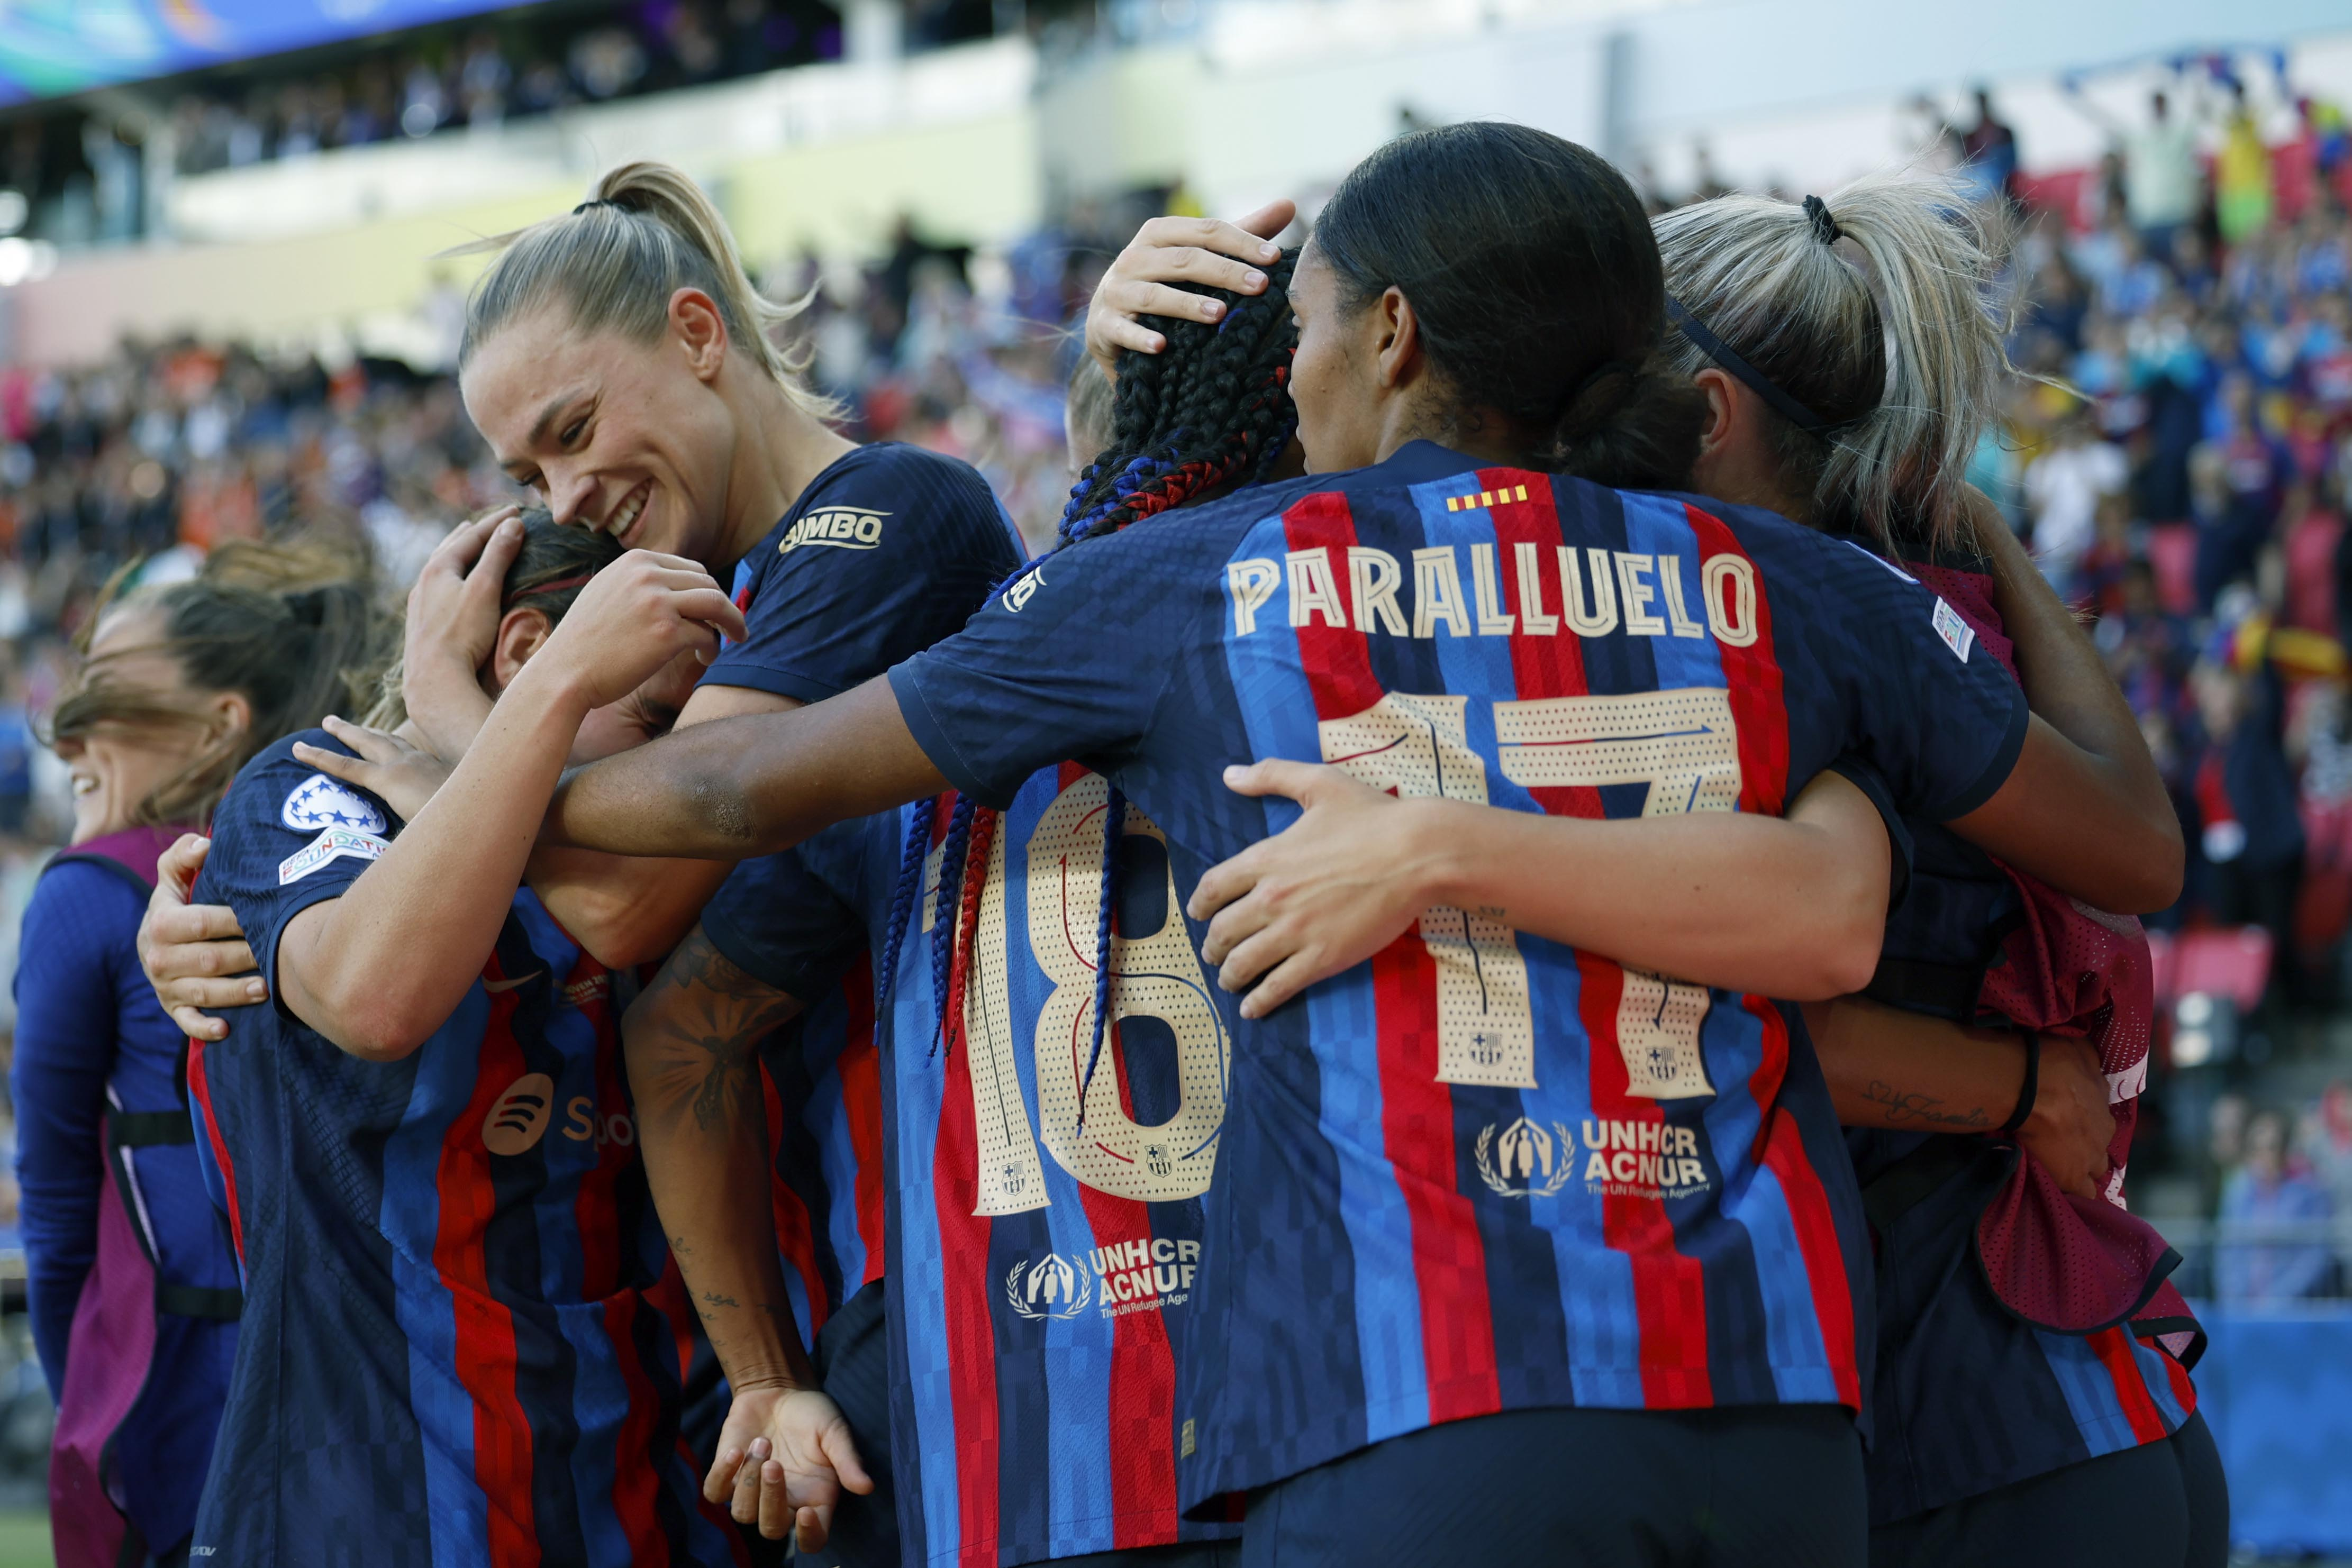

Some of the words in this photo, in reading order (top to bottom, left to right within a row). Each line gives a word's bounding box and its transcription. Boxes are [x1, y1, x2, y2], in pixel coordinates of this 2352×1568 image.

[779, 513, 882, 554] BIMBO
[1227, 542, 1758, 647] PARALLUELO
[283, 835, 386, 879] FOUNDATI
[1319, 687, 1742, 1099] 17
[922, 771, 1231, 1216] 18
[562, 1096, 635, 1152] Spo
[1582, 1120, 1698, 1156] UNHCR
[1584, 1151, 1707, 1186] ACNUR
[1586, 1184, 1608, 1195] The
[1610, 1184, 1627, 1196] UN
[1628, 1186, 1666, 1200] Refugee
[1669, 1182, 1710, 1199] Agency
[1089, 1238, 1201, 1275] UNHCR
[1100, 1308, 1118, 1318] The
[1118, 1303, 1131, 1315] UN
[1131, 1296, 1165, 1312] Refugee
[1167, 1293, 1188, 1306] Age
